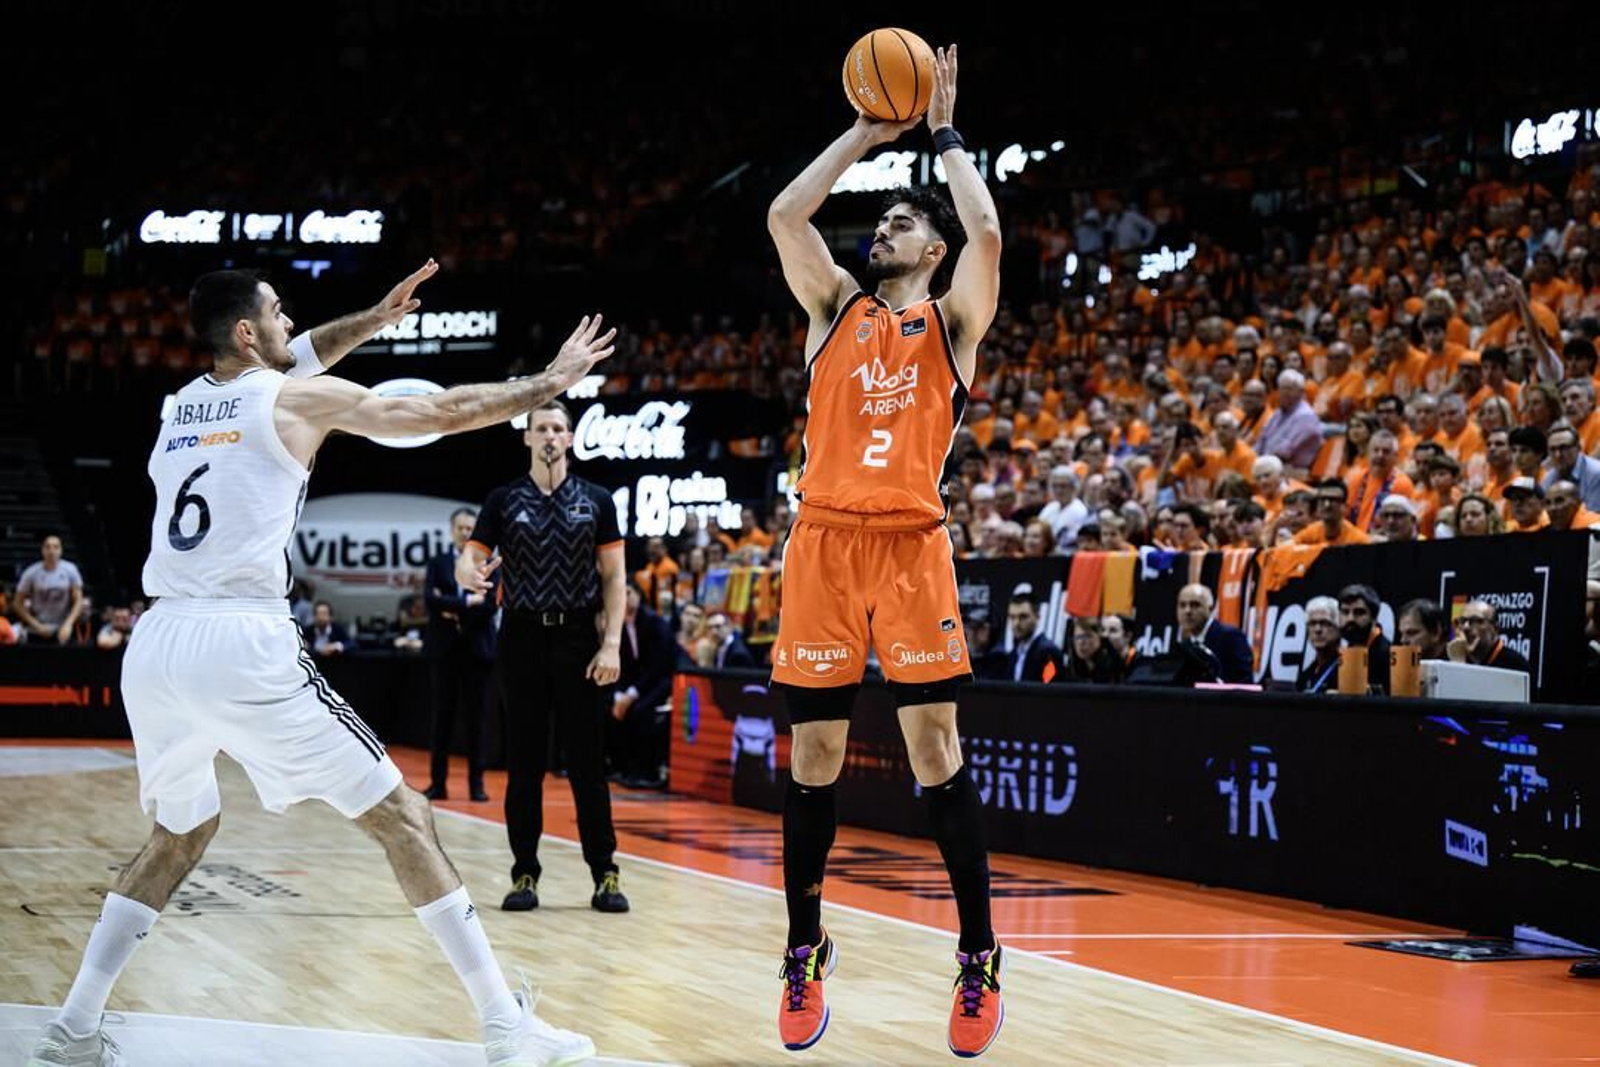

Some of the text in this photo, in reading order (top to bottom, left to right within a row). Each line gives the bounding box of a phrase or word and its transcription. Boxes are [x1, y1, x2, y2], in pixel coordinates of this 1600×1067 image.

[421, 311, 497, 338] BOSCH
[172, 398, 242, 426] ABALDE
[859, 391, 916, 415] ARENA
[166, 431, 242, 453] AUTOHERO
[862, 429, 893, 468] 2
[168, 462, 211, 551] 6
[797, 648, 848, 661] PULEVA
[899, 650, 945, 665] Midea
